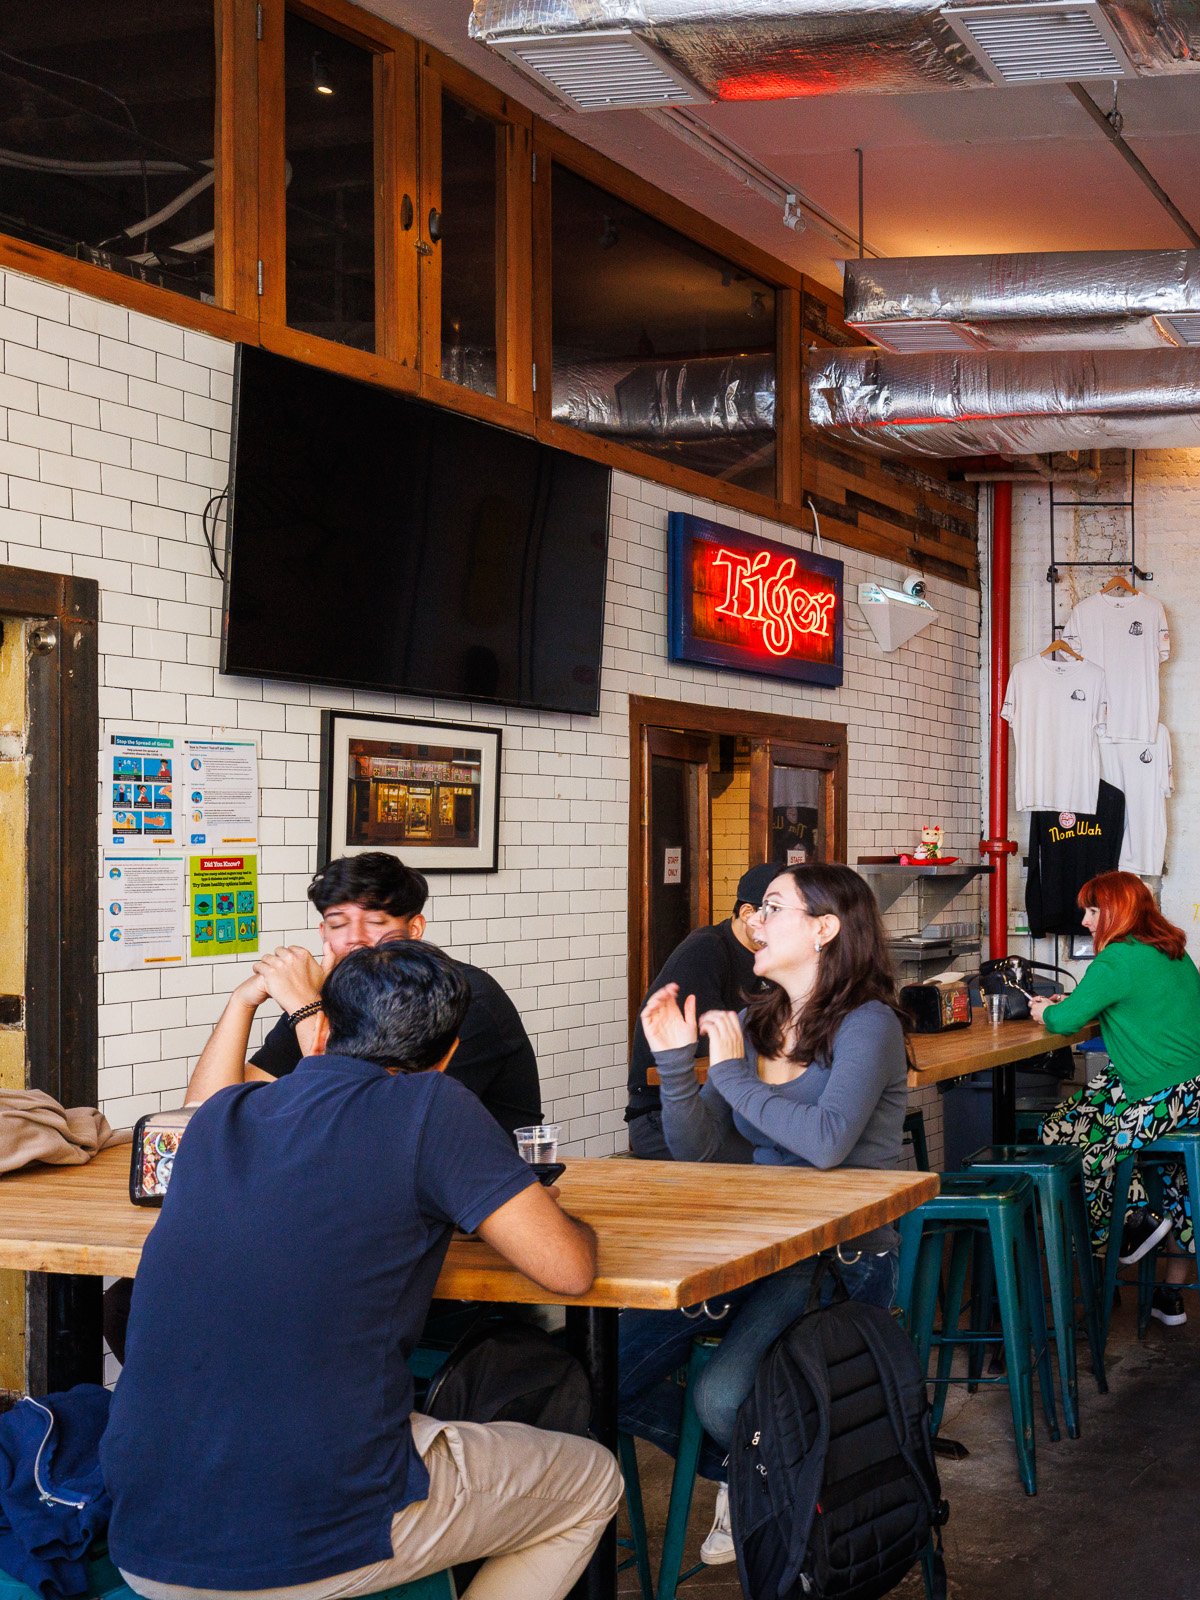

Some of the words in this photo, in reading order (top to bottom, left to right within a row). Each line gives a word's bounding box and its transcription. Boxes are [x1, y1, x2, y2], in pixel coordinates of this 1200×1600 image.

[712, 548, 836, 656] Tiger
[1076, 821, 1102, 836] Wah
[667, 856, 679, 864] STAFF
[668, 869, 678, 877] ONLY
